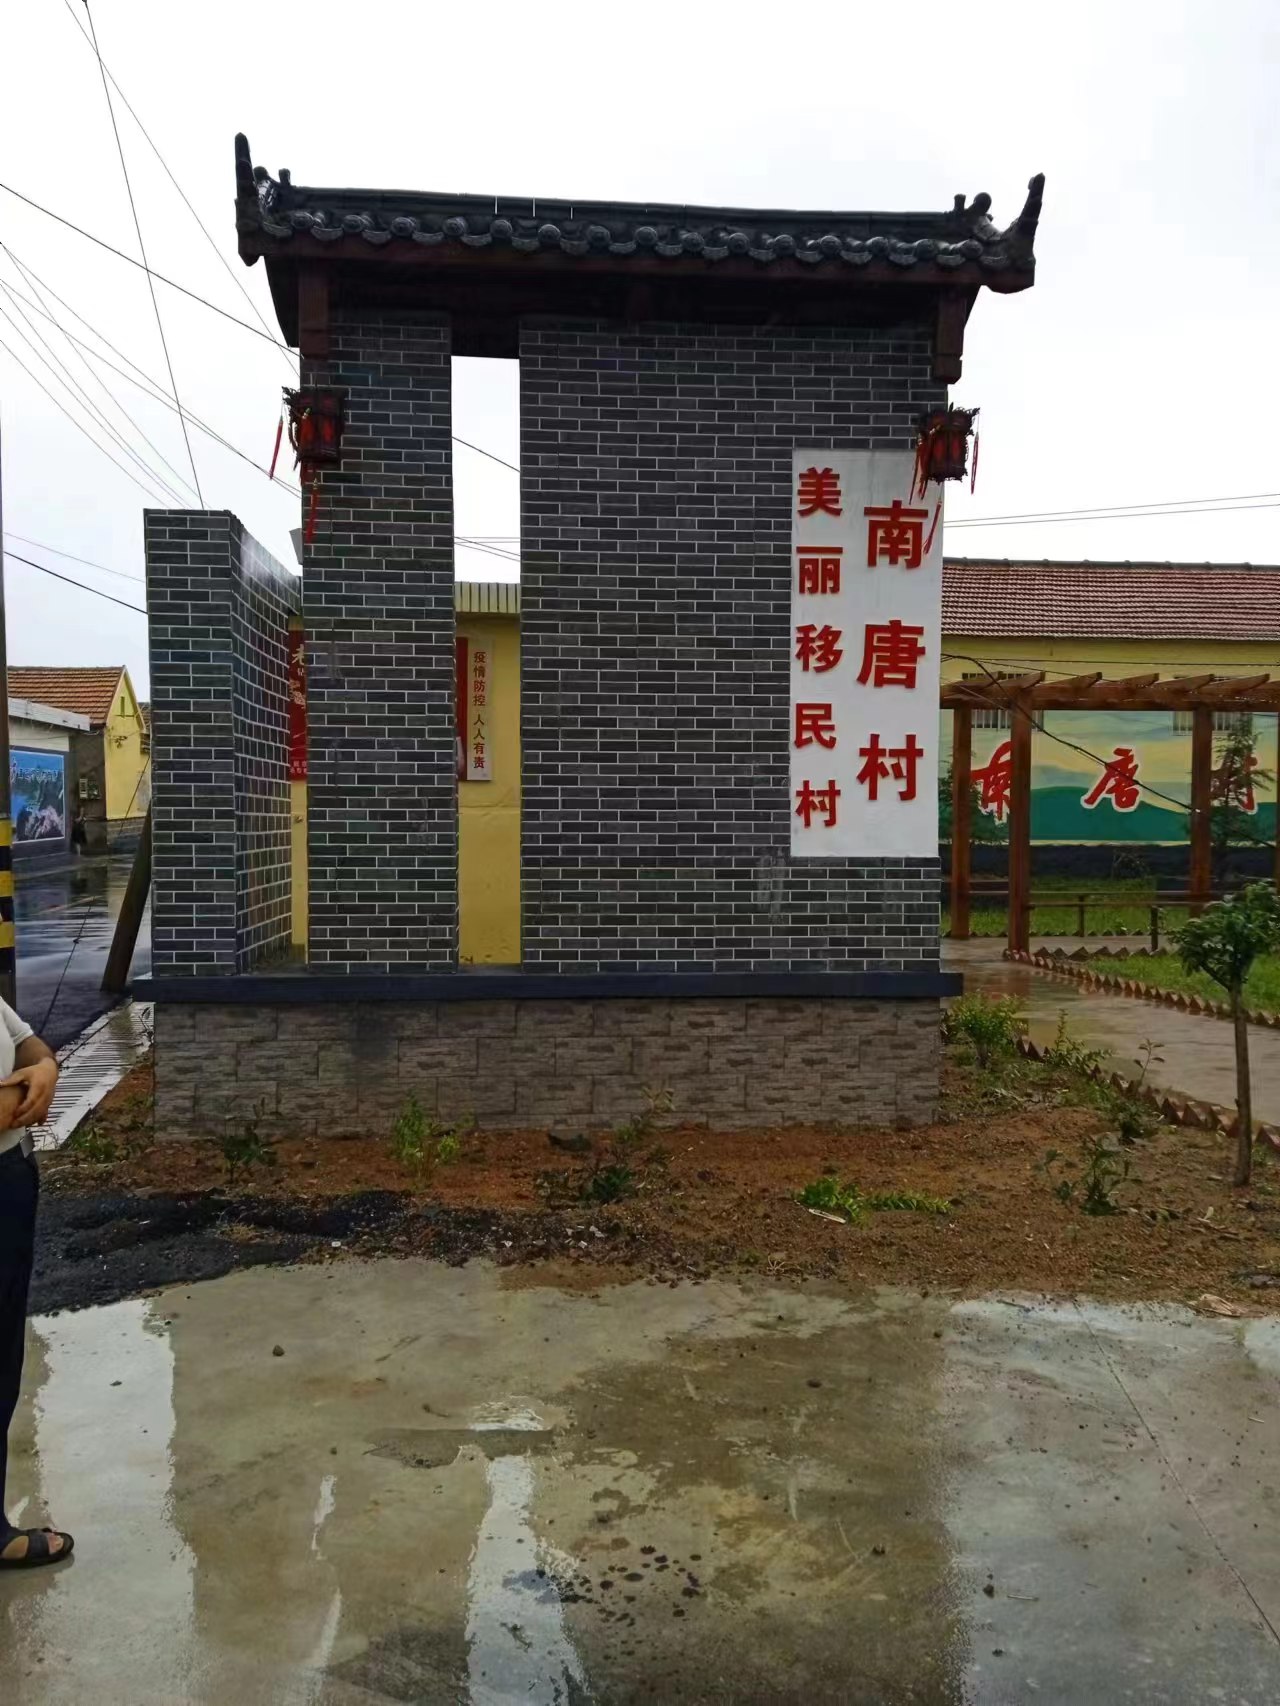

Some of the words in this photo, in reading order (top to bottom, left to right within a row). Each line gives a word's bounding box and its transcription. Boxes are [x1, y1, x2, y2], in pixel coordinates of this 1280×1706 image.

[473, 651, 486, 706] 疫情防控
[794, 467, 844, 828] 美丽移民村
[856, 500, 929, 801] 南唐村
[473, 714, 486, 769] 人人有责
